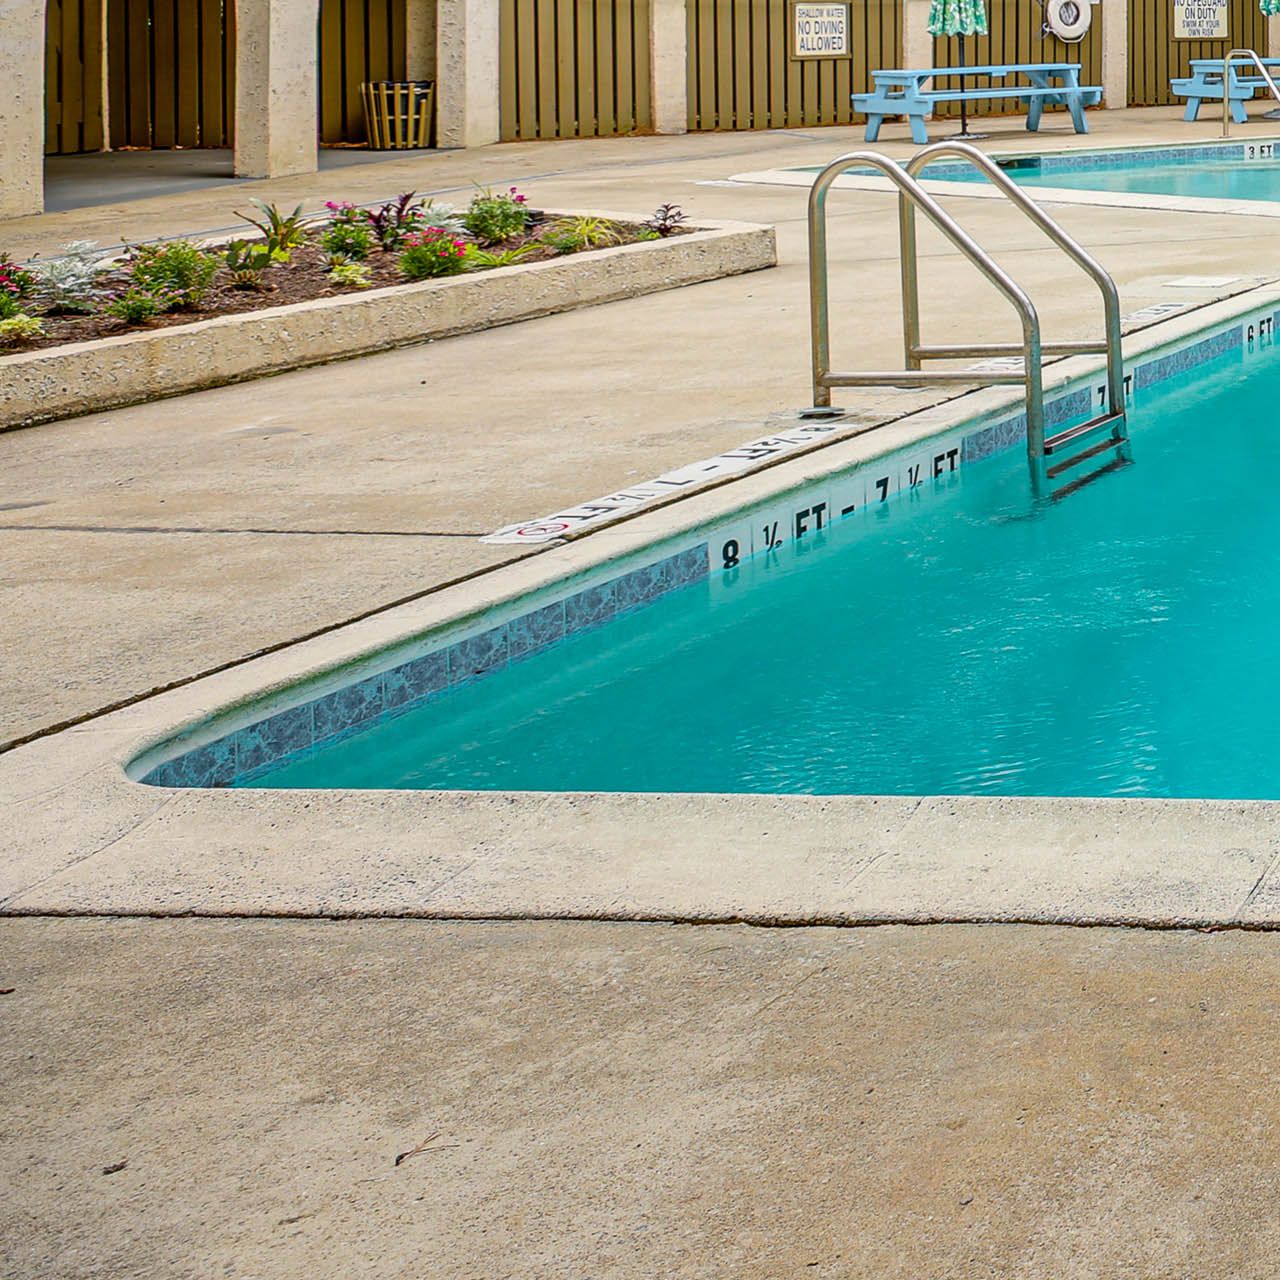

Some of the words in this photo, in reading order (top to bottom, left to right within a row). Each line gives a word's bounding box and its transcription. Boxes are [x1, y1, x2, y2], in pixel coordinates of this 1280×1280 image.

[1185, 7, 1196, 19] ON
[1197, 7, 1217, 19] DUTY
[798, 20, 811, 35] NO
[814, 20, 844, 35] DIVING
[799, 36, 843, 51] ALLOWED
[1259, 145, 1272, 157] FT
[1259, 317, 1272, 337] FT
[1097, 385, 1106, 407] 7
[722, 539, 740, 569] 8
[795, 502, 827, 539] FT
[876, 476, 889, 502] 7
[933, 448, 959, 479] FT
